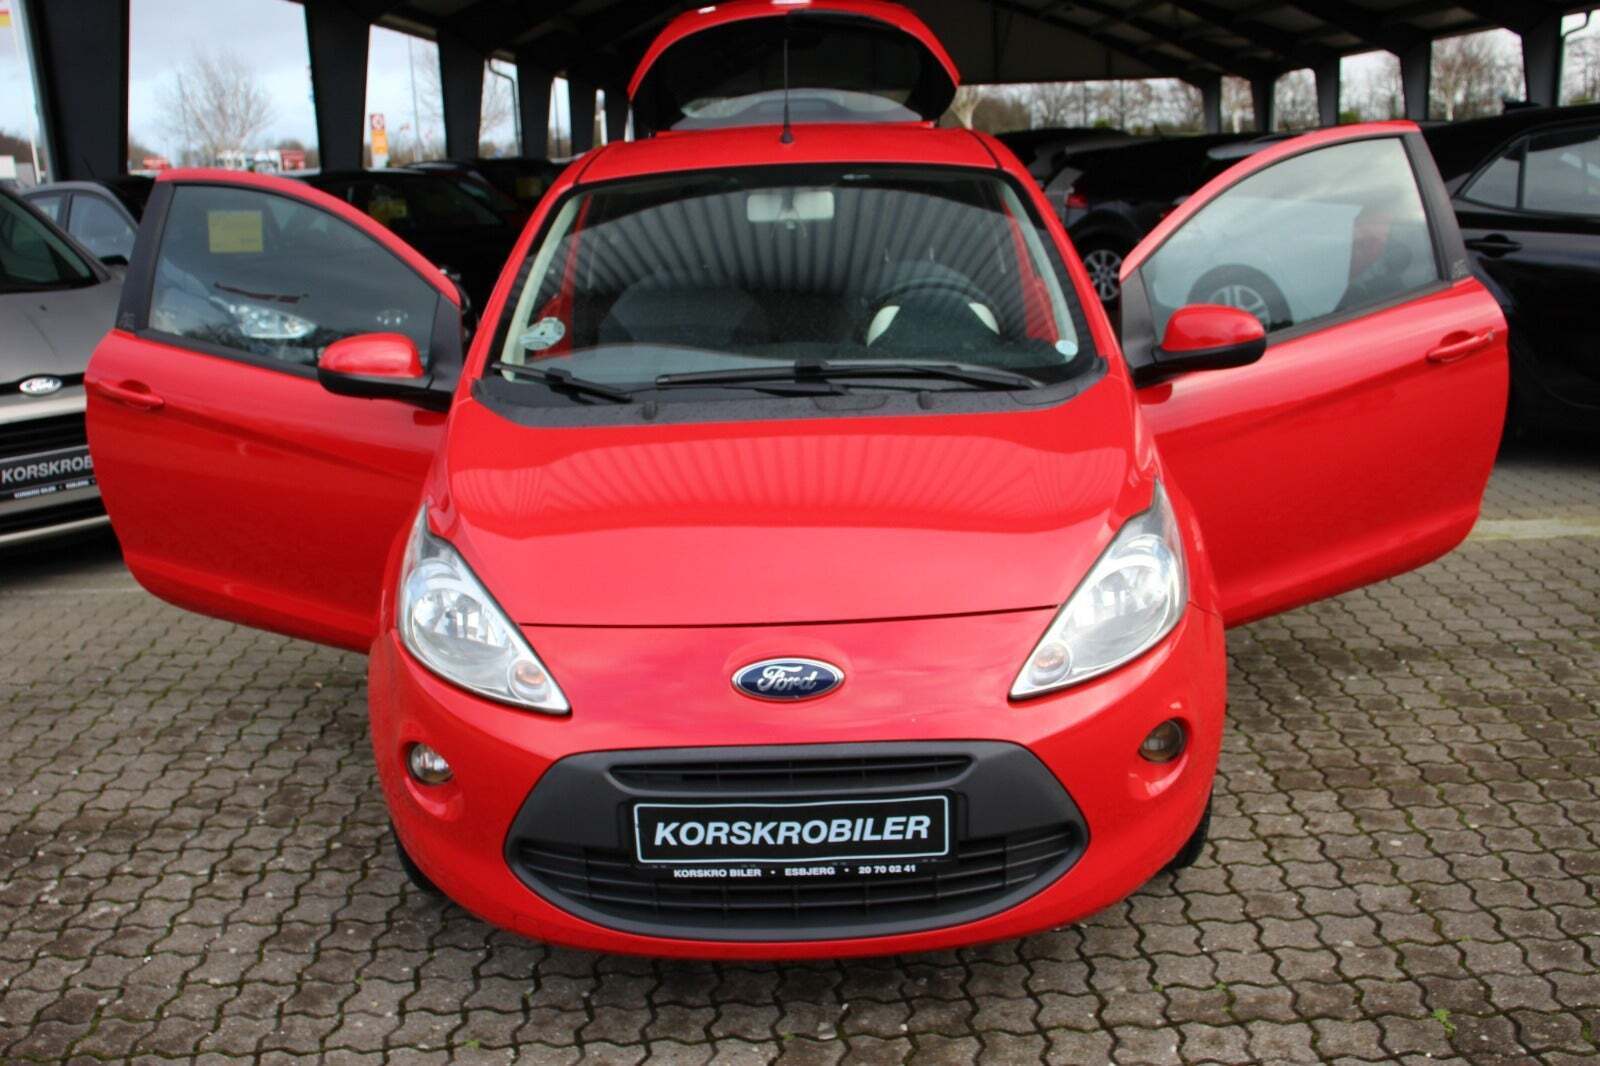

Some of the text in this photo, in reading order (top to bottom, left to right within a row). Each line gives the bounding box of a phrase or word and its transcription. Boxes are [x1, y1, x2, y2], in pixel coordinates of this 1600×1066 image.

[757, 665, 818, 692] Ford
[654, 815, 931, 846] KORSKROBILER
[674, 864, 917, 878] KORSKRO BILER ESBJERG 20 70 02 41
